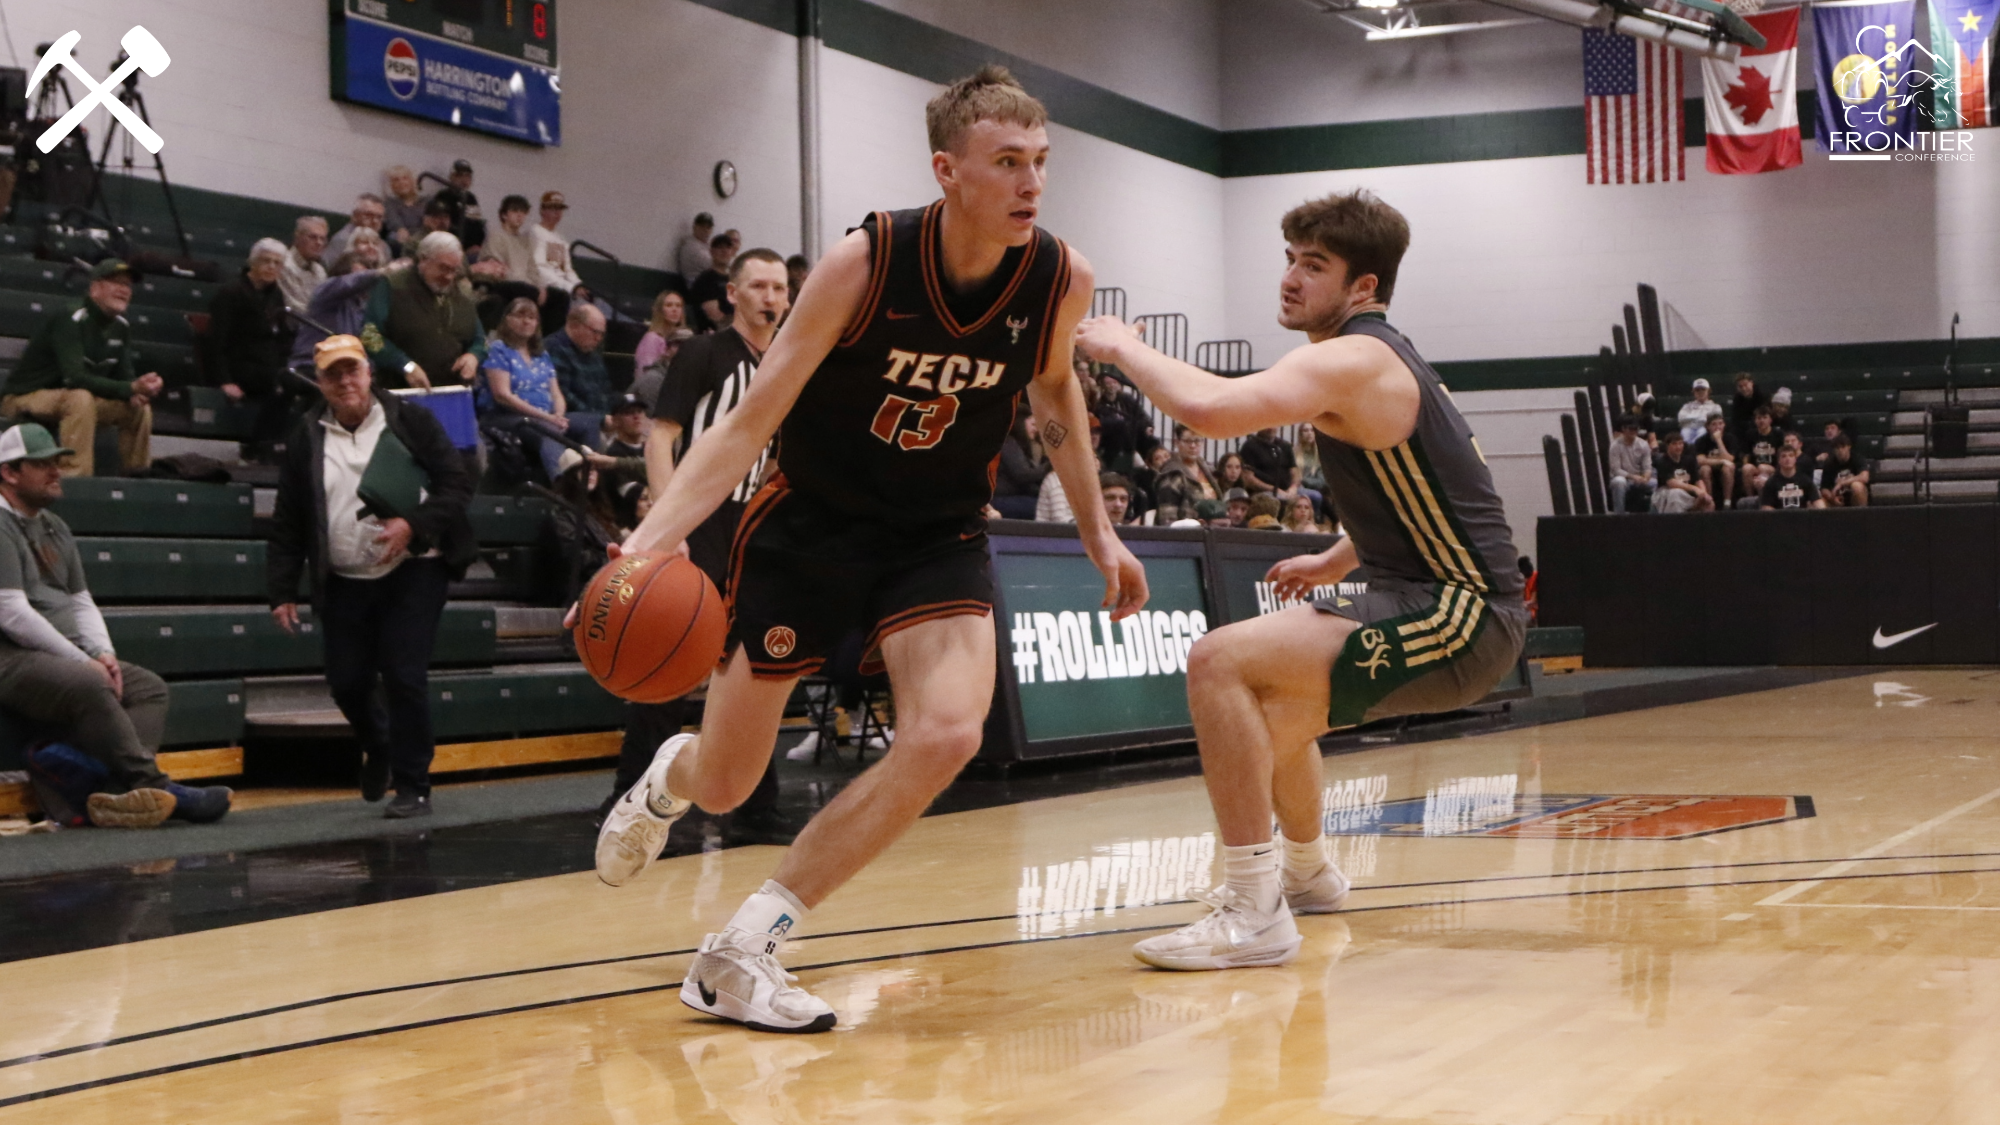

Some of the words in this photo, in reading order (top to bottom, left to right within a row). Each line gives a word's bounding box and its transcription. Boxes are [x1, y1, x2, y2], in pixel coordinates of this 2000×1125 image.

[387, 60, 416, 78] PEPSI
[424, 58, 513, 99] HARRINGTON
[1885, 24, 1897, 126] MONTANA
[881, 347, 1007, 394] TECH
[870, 393, 960, 451] 13
